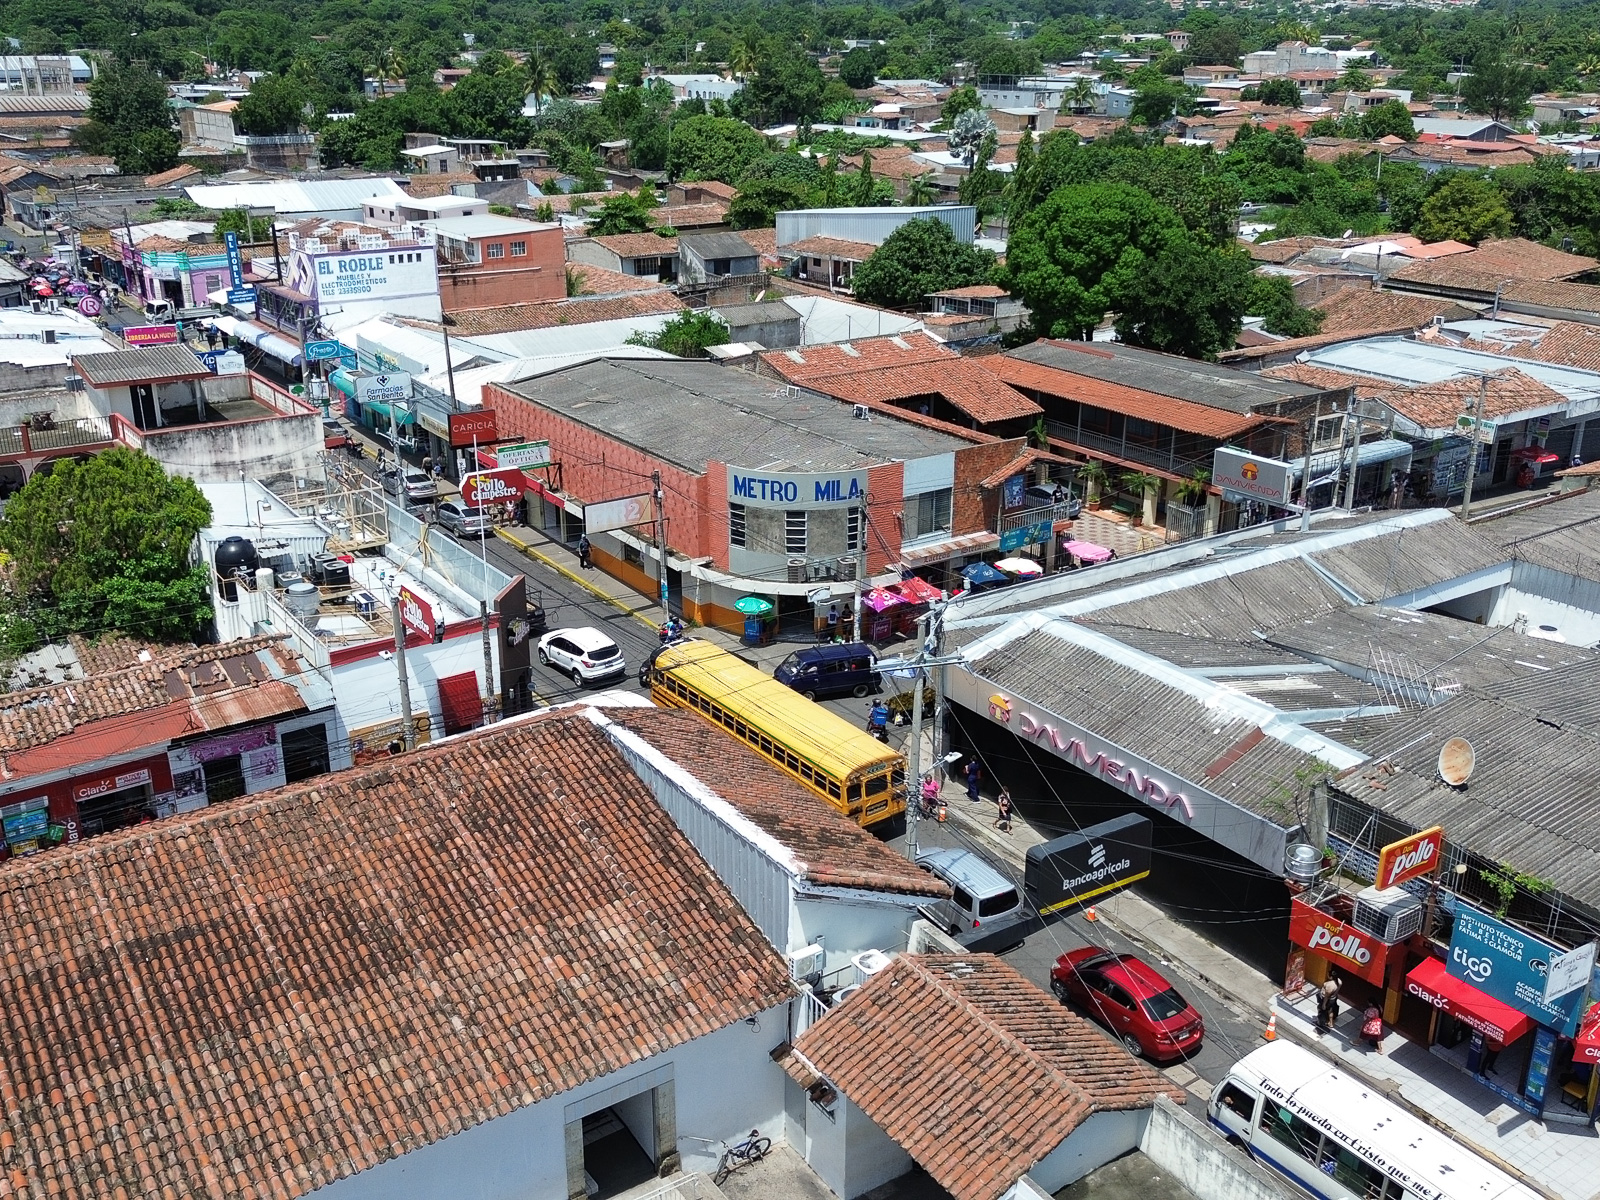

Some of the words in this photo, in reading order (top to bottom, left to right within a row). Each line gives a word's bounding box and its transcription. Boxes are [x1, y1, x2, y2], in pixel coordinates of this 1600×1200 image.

[227, 235, 234, 248] EL
[230, 251, 240, 285] ROBLE
[318, 260, 334, 275] EL
[338, 257, 384, 273] ROBLE
[366, 385, 404, 396] Farmacias
[367, 393, 381, 402] San
[381, 391, 404, 400] Benito
[452, 420, 494, 433] CARICIA
[502, 449, 535, 459] OFERTAS
[733, 474, 798, 502] METRO
[814, 478, 860, 501] MILA
[1215, 474, 1282, 497] DAVIVIENDA
[1018, 712, 1194, 820] DAVIVIENDA
[79, 785, 108, 798] Claro
[67, 821, 80, 844] laro
[1387, 838, 1434, 885] pollo
[1062, 857, 1131, 891] Bancoagrícola
[1324, 921, 1340, 934] Don
[1461, 913, 1495, 933] INSTITUTO
[1308, 925, 1371, 964] pollo
[1460, 919, 1473, 929] DE
[1478, 928, 1523, 956] BELLEZA
[1488, 941, 1523, 962] GLAMOUR
[1453, 946, 1493, 983] tigo
[1408, 983, 1444, 1009] Claro
[1259, 1079, 1284, 1099] Todo
[1285, 1095, 1297, 1108] lo
[1296, 1106, 1332, 1131] puedo
[1333, 1129, 1349, 1142] en
[1350, 1138, 1386, 1166] Cristo
[1387, 1165, 1411, 1182] que
[1412, 1181, 1431, 1196] me
